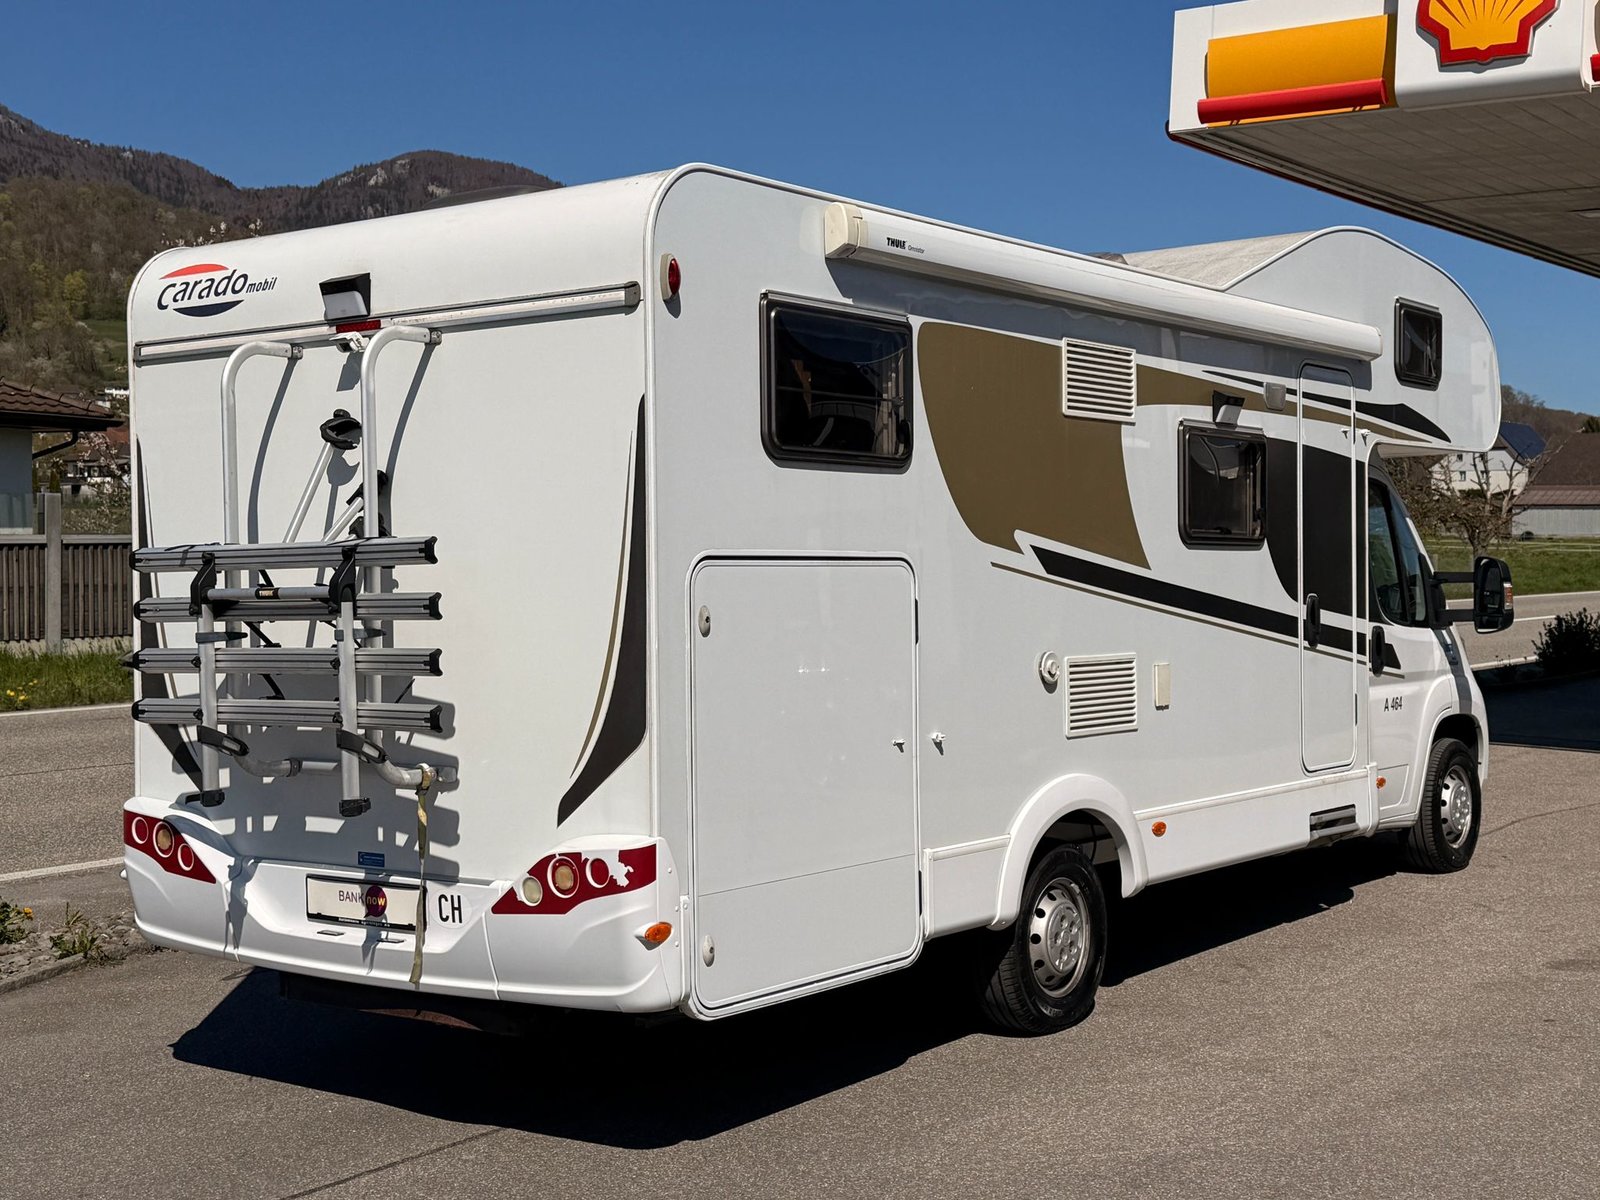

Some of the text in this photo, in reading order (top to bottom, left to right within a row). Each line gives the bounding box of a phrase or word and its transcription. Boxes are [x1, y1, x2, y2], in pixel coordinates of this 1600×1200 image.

[886, 237, 906, 250] THULE
[246, 277, 277, 293] mobil
[1383, 695, 1402, 712] A 464
[338, 890, 386, 906] BANK now
[438, 894, 463, 924] CH
